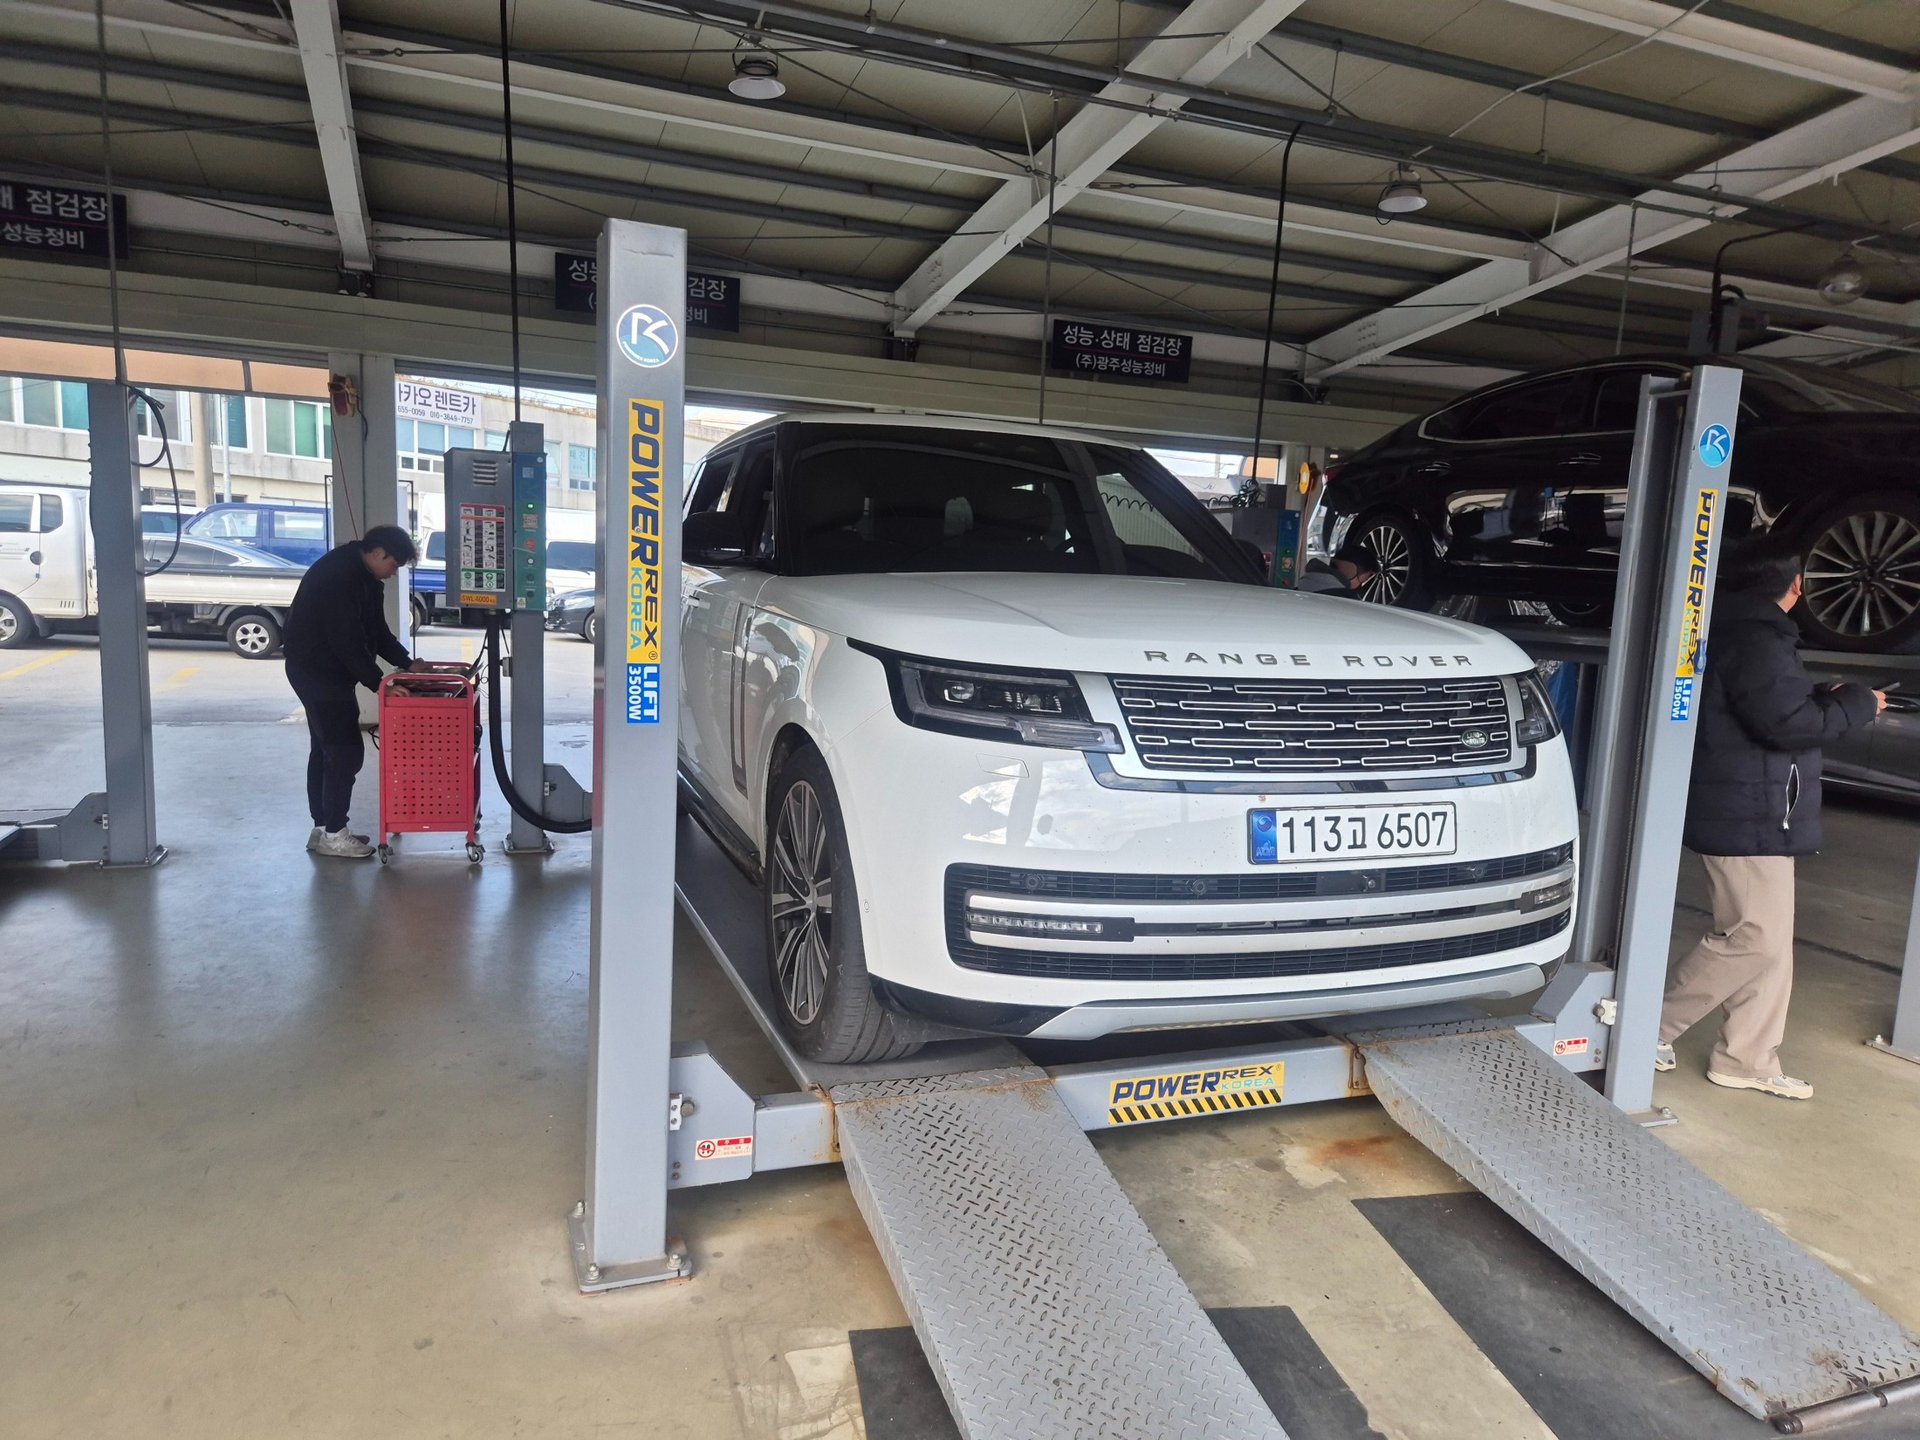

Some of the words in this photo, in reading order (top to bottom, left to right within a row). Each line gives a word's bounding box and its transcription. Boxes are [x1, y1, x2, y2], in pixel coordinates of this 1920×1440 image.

[26, 188, 108, 221] 점검장
[688, 276, 727, 301] 검장
[1137, 334, 1182, 357] 점검장
[1075, 352, 1166, 377] (주)광주성능정비
[435, 390, 477, 415] 렌트카
[630, 567, 643, 650] KOREA
[1144, 650, 1311, 667] RANGE
[1342, 654, 1472, 668] ROVER
[628, 666, 642, 721] 3500W
[643, 666, 658, 720] LIFT
[1671, 678, 1684, 719] 3500W
[1680, 678, 1692, 719] LIFT
[1377, 811, 1448, 850] 6507
[1221, 1077, 1275, 1091] KOREA
